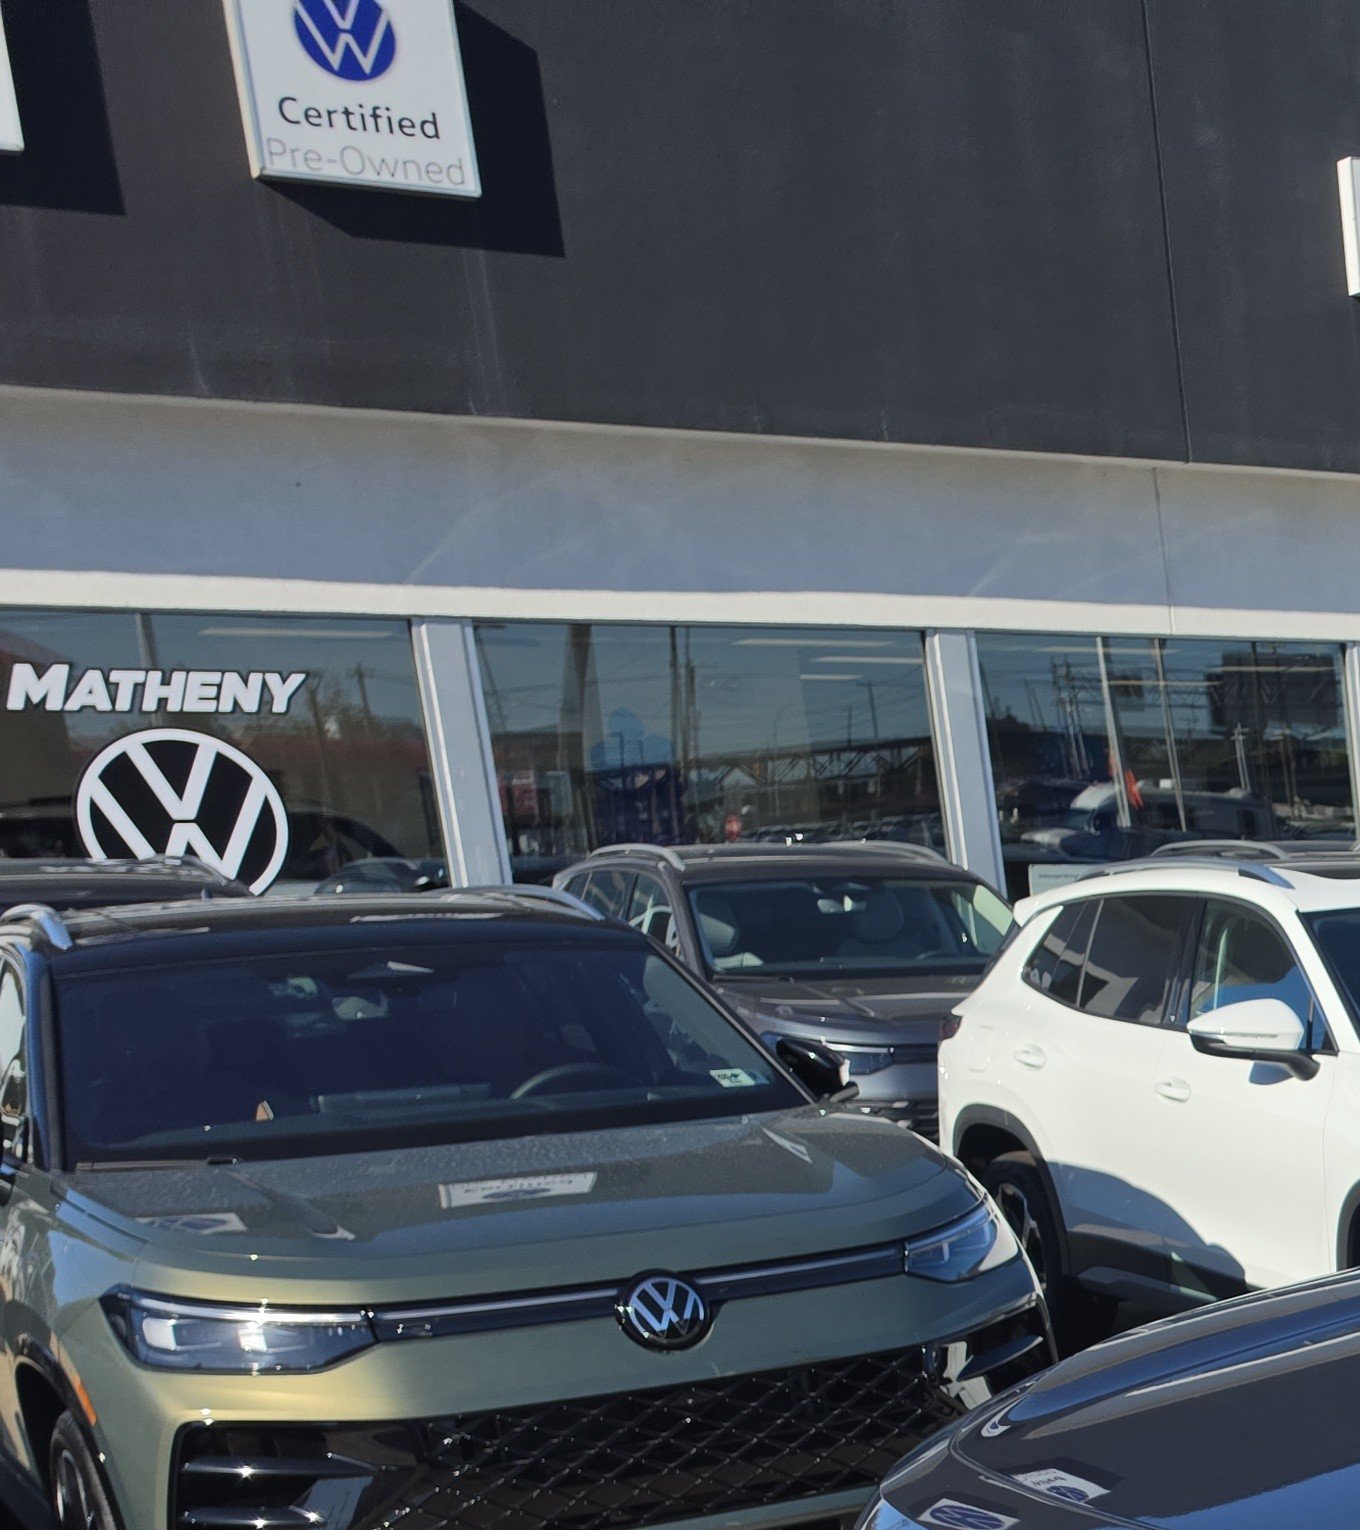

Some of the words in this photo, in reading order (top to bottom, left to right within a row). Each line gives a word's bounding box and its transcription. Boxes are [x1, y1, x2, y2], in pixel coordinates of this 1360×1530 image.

[278, 96, 440, 139] Certified
[266, 137, 466, 186] Pre-Owned
[6, 662, 307, 713] MATHENY
